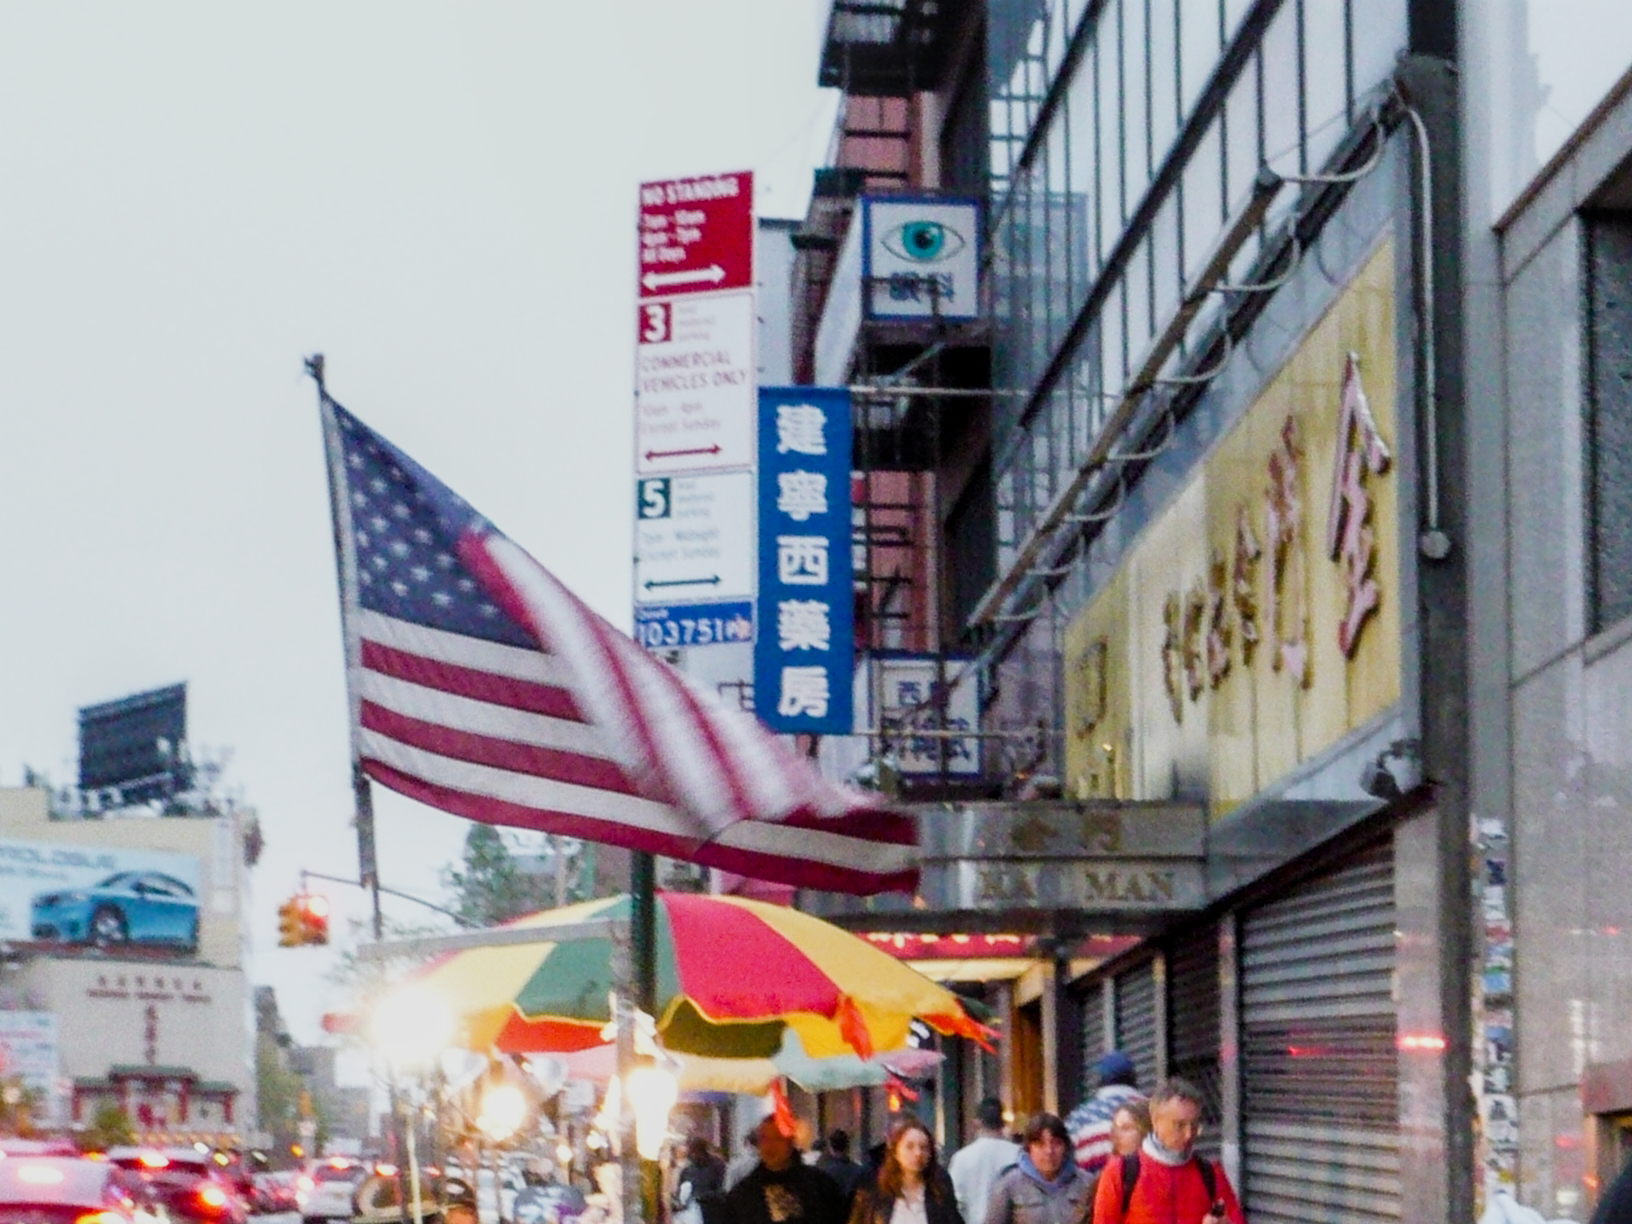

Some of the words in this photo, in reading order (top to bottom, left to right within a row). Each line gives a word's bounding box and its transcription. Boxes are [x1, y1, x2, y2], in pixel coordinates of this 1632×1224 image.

[666, 177, 740, 205] STANDING
[645, 303, 666, 341] 3
[642, 350, 732, 373] COMMERCIAL
[643, 372, 708, 393] VEHICLES
[712, 369, 747, 388] ONLY
[643, 480, 665, 517] 5
[1080, 866, 1174, 904] MAN
